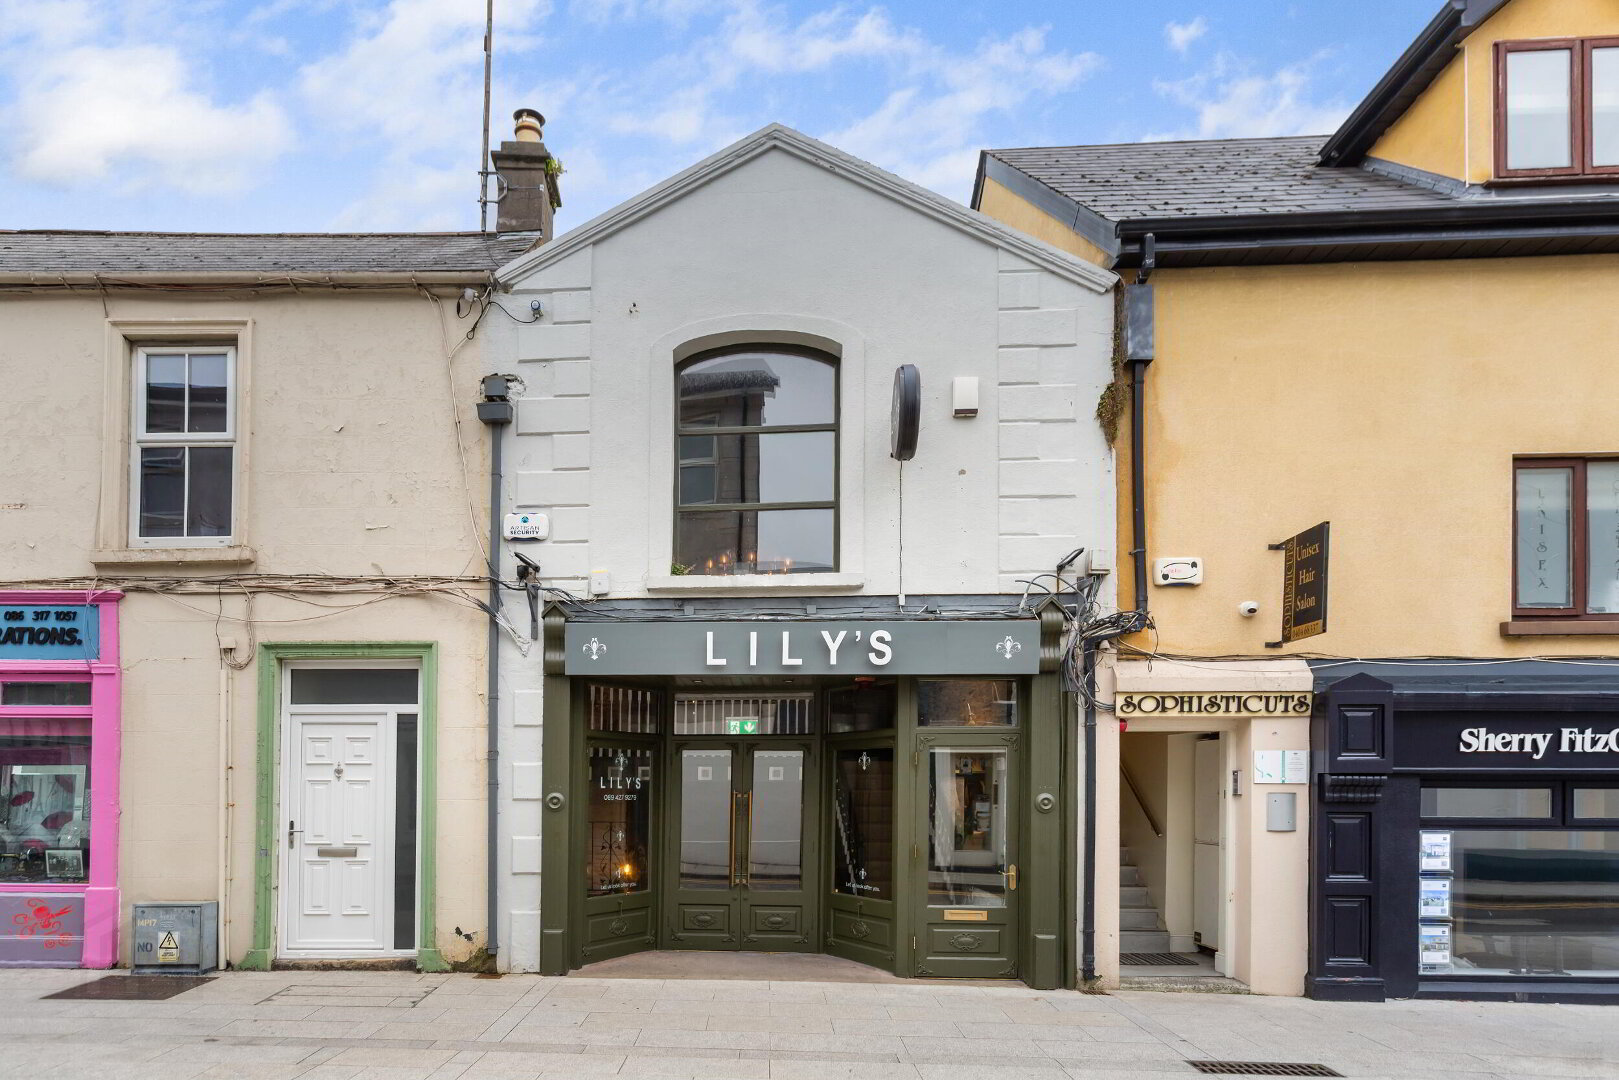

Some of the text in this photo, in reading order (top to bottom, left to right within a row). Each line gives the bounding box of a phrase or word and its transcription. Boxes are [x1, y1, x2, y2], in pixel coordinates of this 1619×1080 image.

[1296, 542, 1320, 561] Unisex
[1298, 567, 1316, 586] Hair
[1283, 541, 1293, 637] SOPHISTICUTS
[1296, 593, 1316, 611] Salon
[4, 610, 78, 621] 086 317 1051
[0, 626, 83, 646] ATIONS.
[706, 629, 892, 666] LILY'S
[1119, 694, 1311, 714] SOPHISTICUTS
[1459, 727, 1554, 760] Sherry
[600, 776, 642, 789] LILY'S
[137, 942, 153, 953] NO
